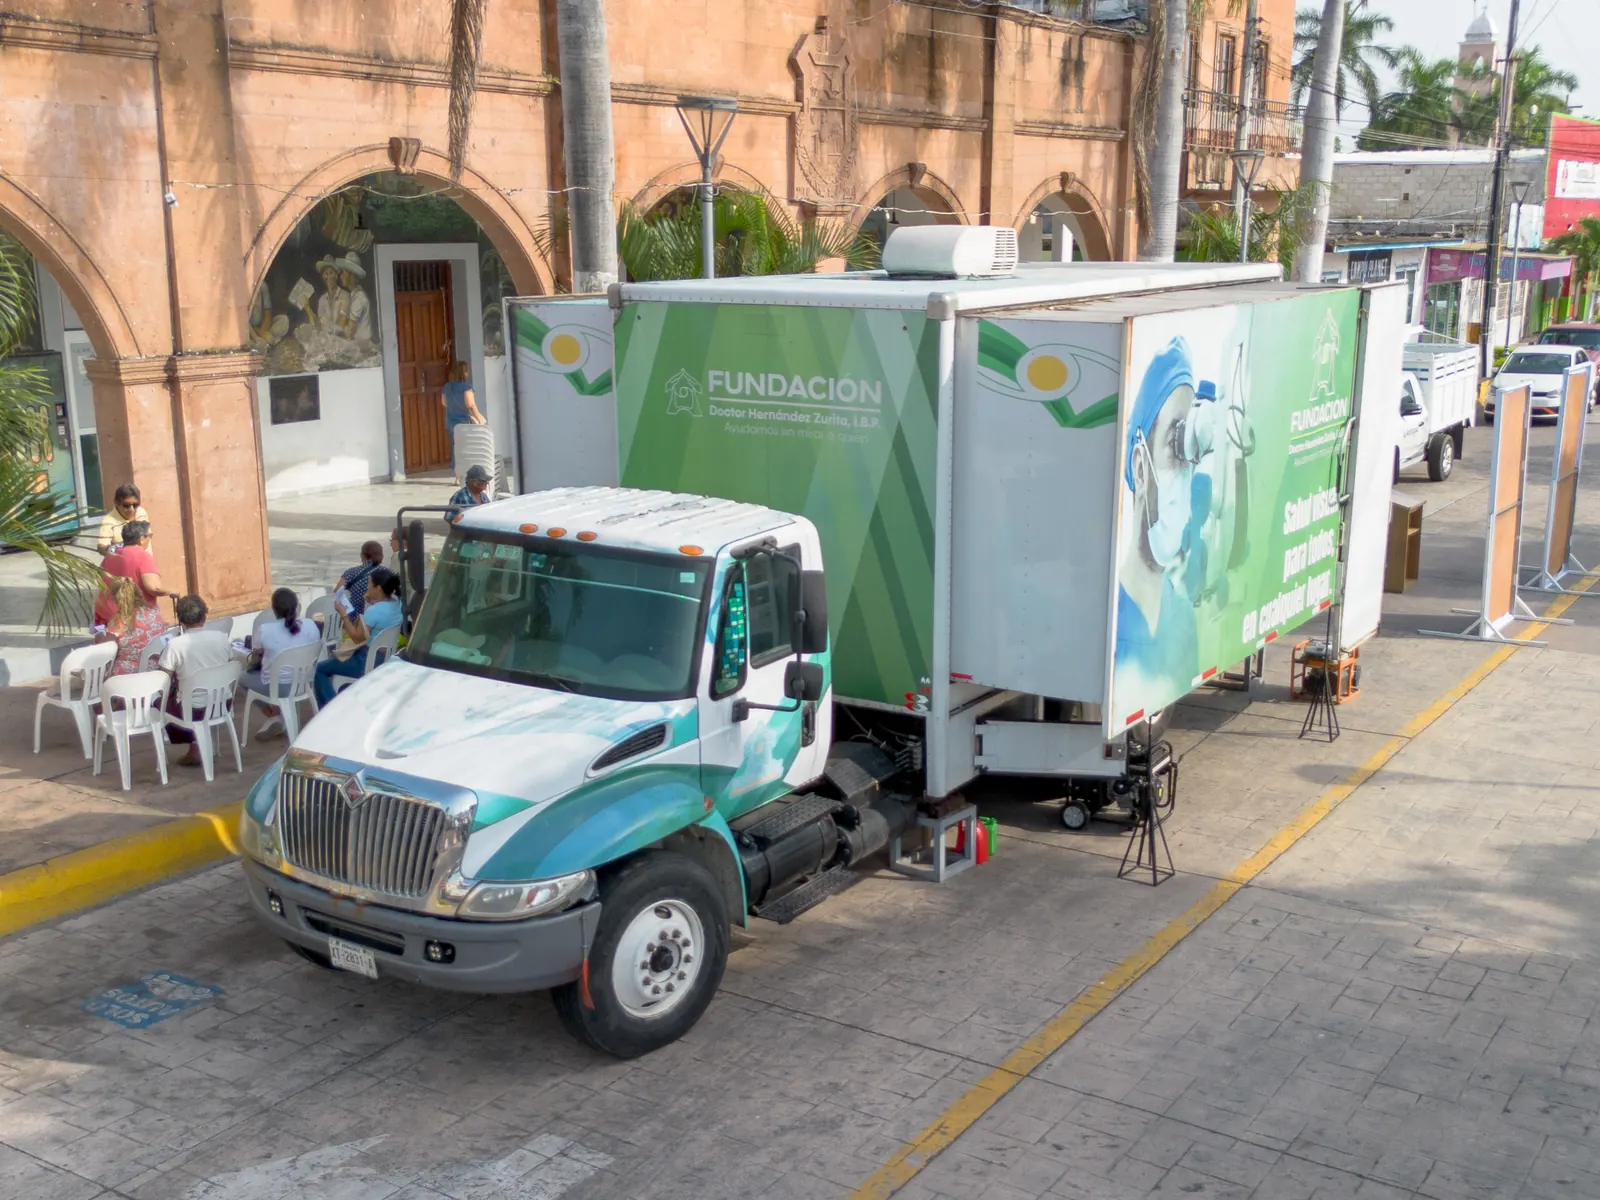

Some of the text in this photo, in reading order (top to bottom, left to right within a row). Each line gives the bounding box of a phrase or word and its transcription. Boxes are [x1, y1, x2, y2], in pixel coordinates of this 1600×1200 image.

[708, 369, 882, 404] FUNDACIÓN
[709, 405, 746, 418] Doctor
[748, 408, 811, 423] Hernández
[813, 412, 851, 428] Zurita,
[724, 420, 780, 437] Ayudamos
[1290, 394, 1348, 433] FUNDACIÓN
[1283, 492, 1312, 535] Salud
[1282, 541, 1307, 583] para
[1242, 610, 1257, 644] en
[1258, 581, 1306, 635] cualquier
